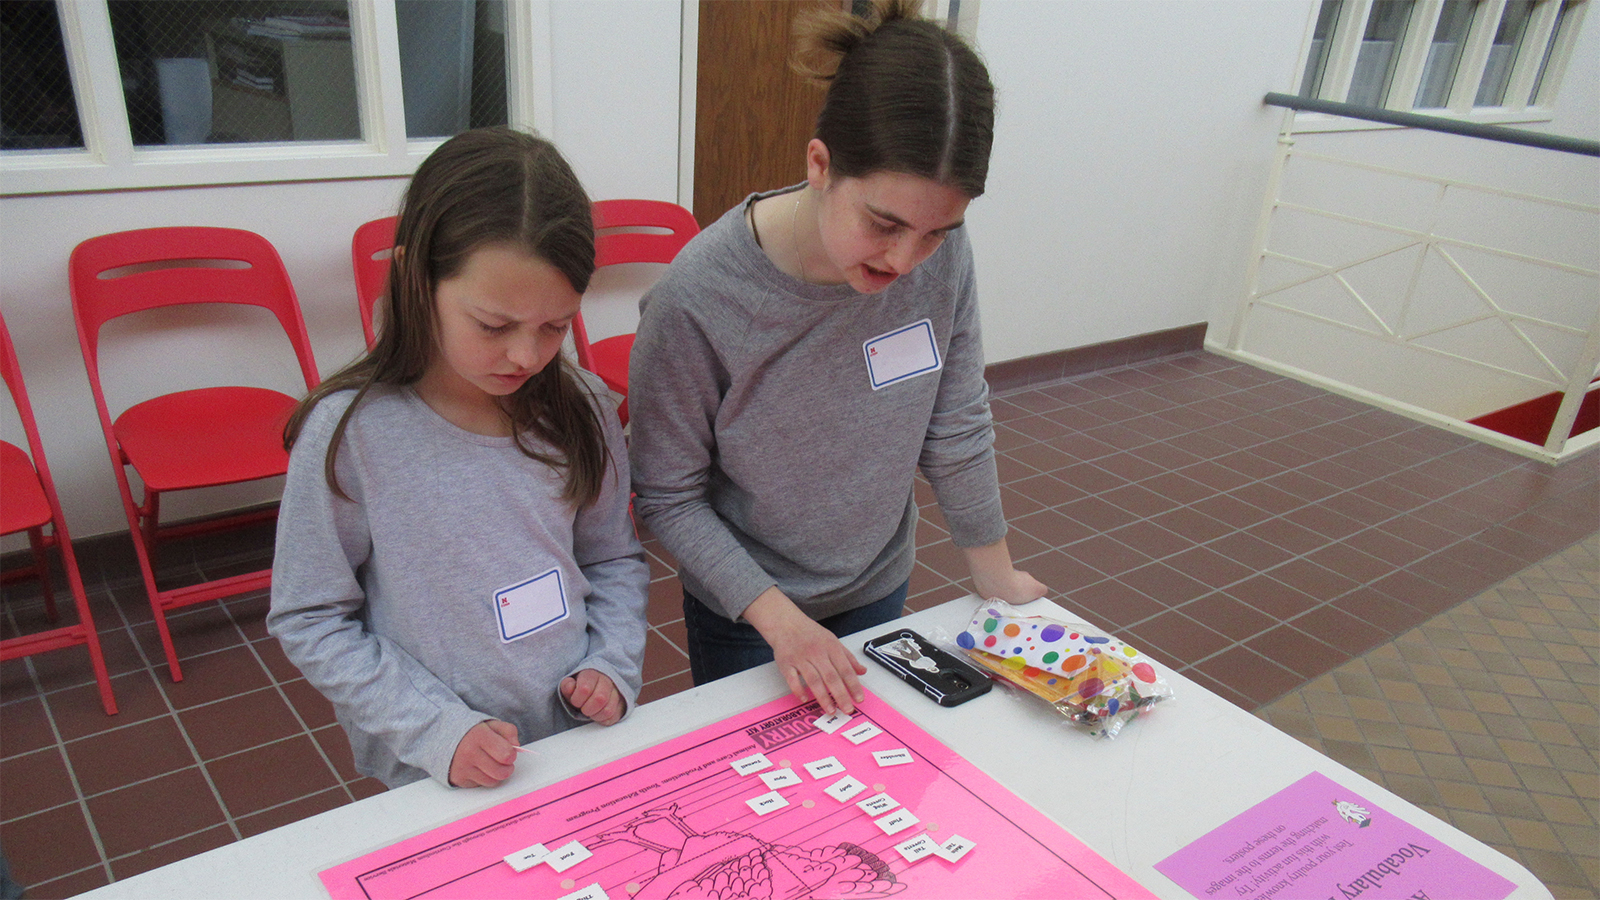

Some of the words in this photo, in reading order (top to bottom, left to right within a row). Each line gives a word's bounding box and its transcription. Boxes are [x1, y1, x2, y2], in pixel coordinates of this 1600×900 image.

[759, 706, 807, 731] LABORATORY
[745, 726, 760, 736] KIT
[760, 711, 824, 748] OULTRY
[733, 744, 756, 757] Animal
[702, 760, 716, 769] and
[716, 753, 733, 763] Care
[741, 759, 761, 769] Toenail
[661, 766, 703, 785] Production:
[638, 783, 660, 794] Youth
[601, 791, 639, 809] Education
[566, 807, 601, 822] Program
[888, 817, 903, 826] Fluff
[1290, 816, 1329, 840] matching
[1273, 824, 1287, 835] on
[1253, 831, 1277, 846] these
[1283, 836, 1298, 848] the
[1311, 833, 1331, 847] with
[913, 846, 926, 854] Tail
[1296, 844, 1315, 857] this
[1333, 839, 1354, 852] Test
[1222, 841, 1255, 864] posters.
[1257, 845, 1285, 863] terms
[1316, 847, 1336, 863] your
[1248, 859, 1262, 869] to
[1282, 853, 1302, 866] fun
[1234, 865, 1253, 878] the
[1250, 862, 1285, 888] activity!
[1286, 858, 1318, 881] poultry
[1336, 843, 1431, 900] Vocabulary
[1204, 873, 1237, 896] images
[1234, 884, 1256, 897] Try
